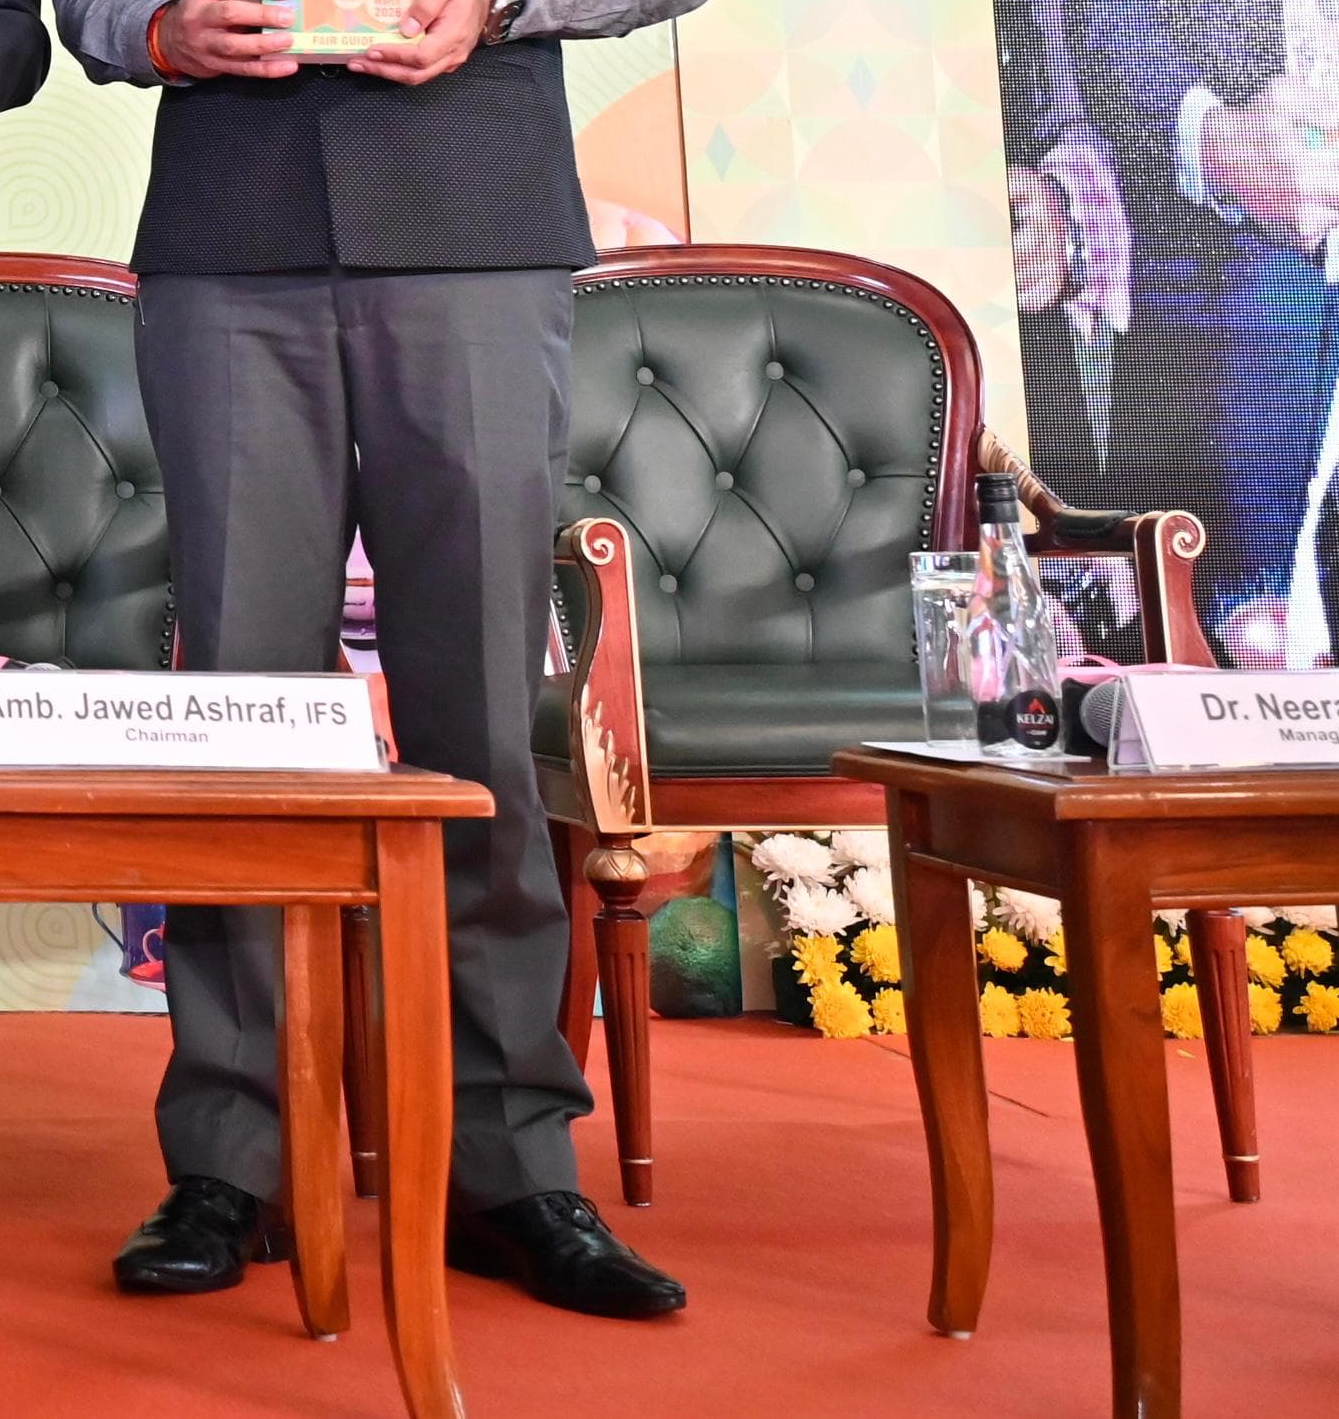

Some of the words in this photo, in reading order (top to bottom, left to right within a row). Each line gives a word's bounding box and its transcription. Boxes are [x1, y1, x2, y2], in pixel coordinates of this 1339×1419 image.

[74, 693, 173, 721] Jawed
[184, 695, 296, 728] Ashraf,
[306, 701, 347, 725] IFS
[1200, 693, 1248, 720] Dr.
[125, 728, 209, 743] Chairman
